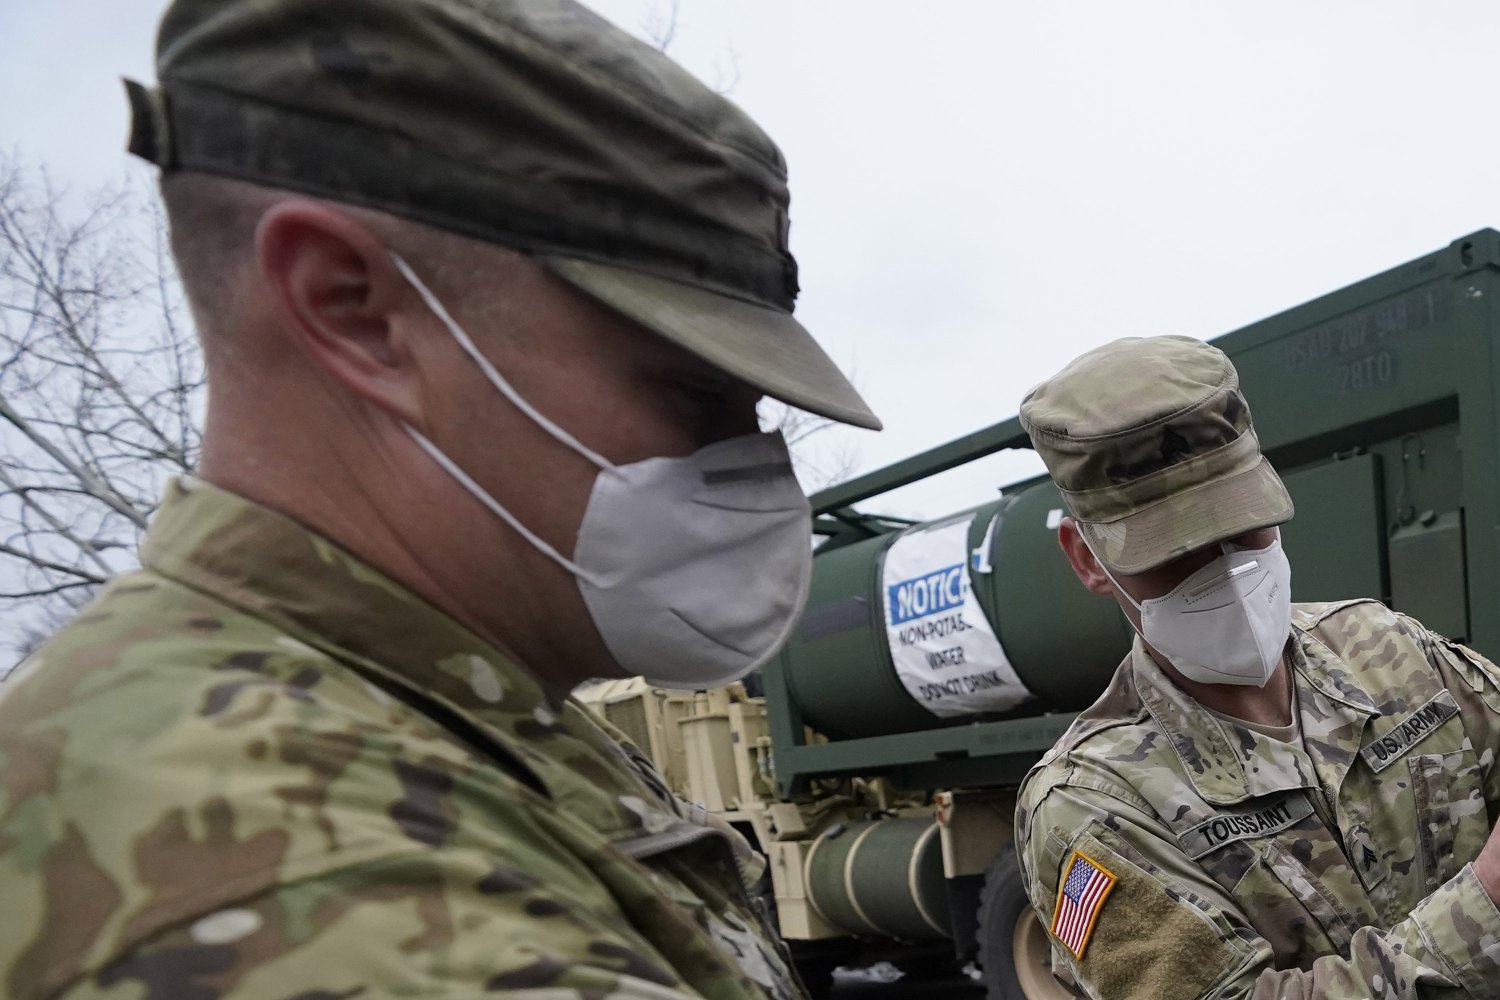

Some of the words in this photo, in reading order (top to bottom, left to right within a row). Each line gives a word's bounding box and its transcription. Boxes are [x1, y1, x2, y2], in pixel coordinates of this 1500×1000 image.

[925, 646, 967, 670] WATER
[1401, 702, 1445, 742] ARMY
[1199, 800, 1292, 847] TOUSSAINT
